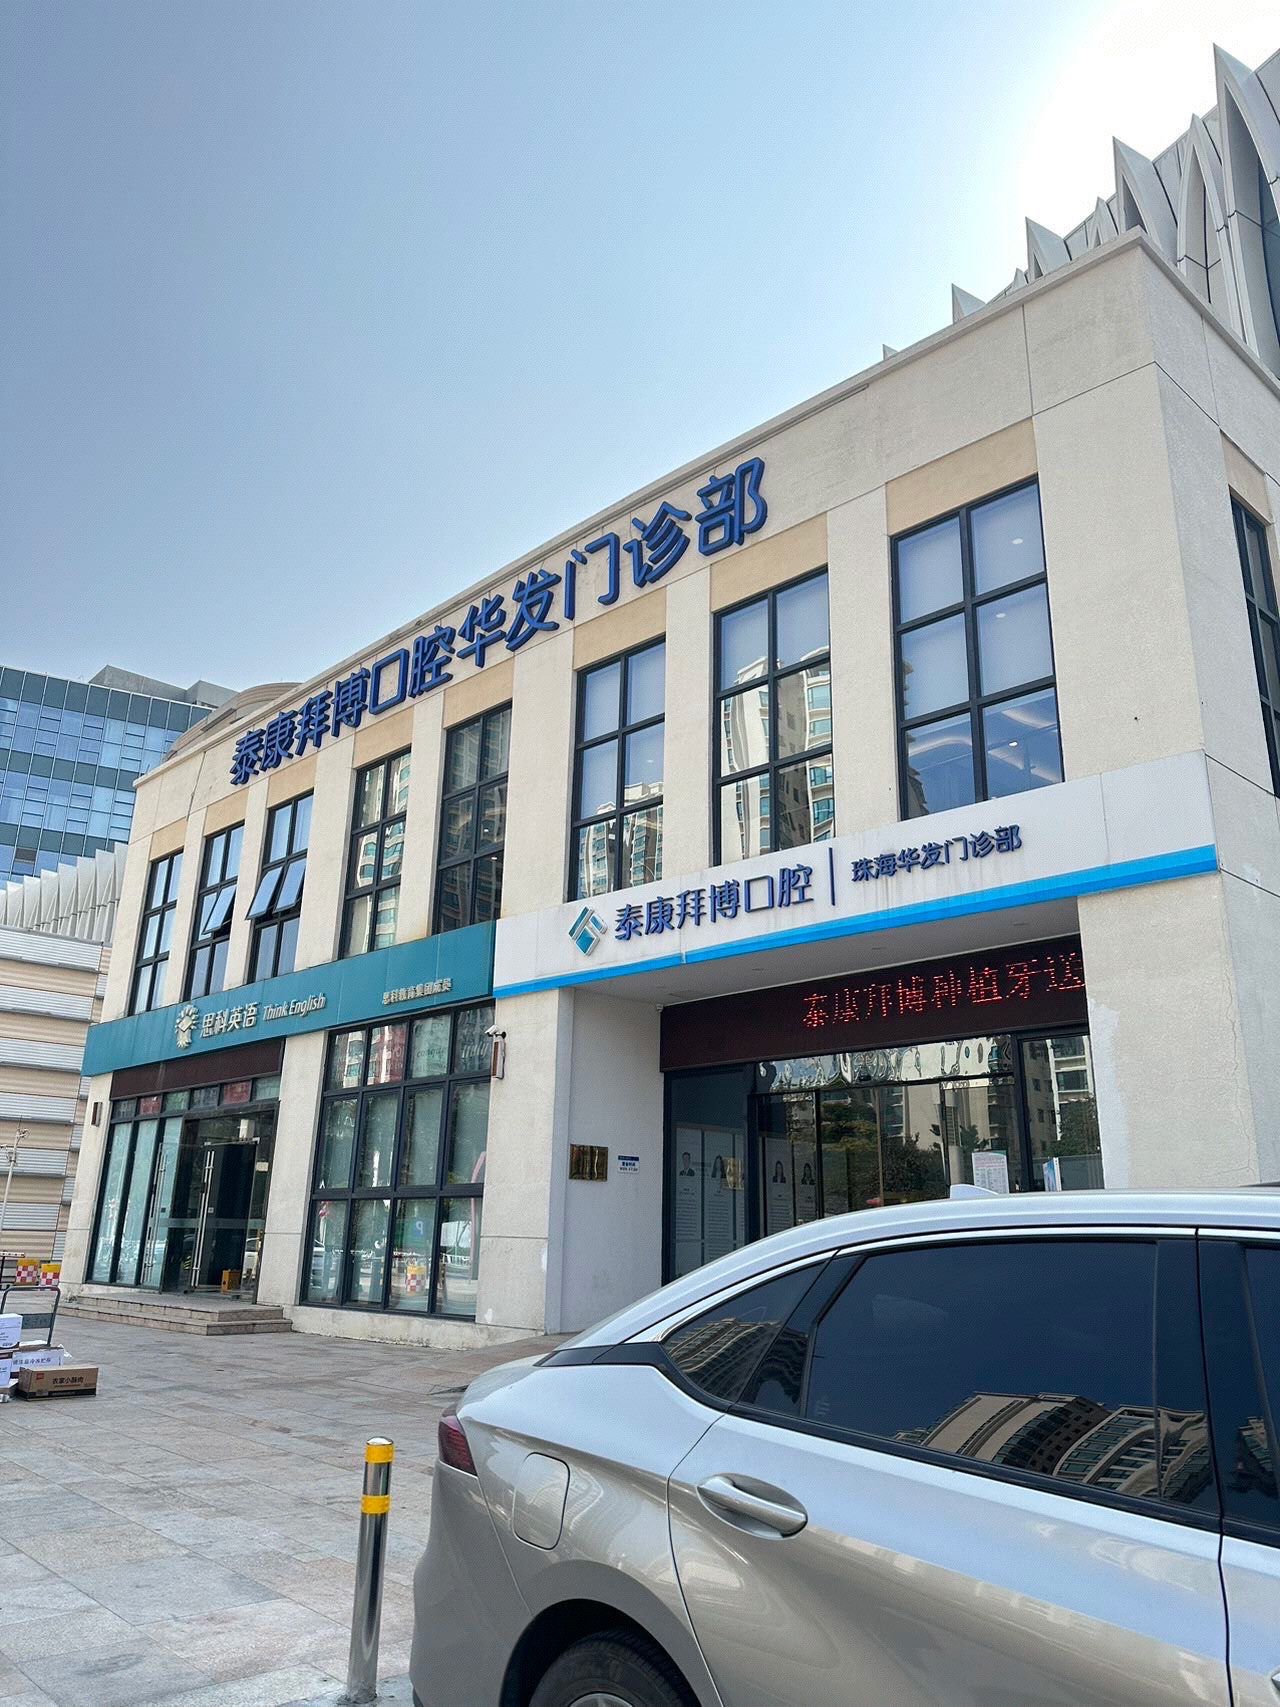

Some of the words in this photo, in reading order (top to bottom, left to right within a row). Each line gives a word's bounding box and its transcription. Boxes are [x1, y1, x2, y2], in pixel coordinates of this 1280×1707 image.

[230, 457, 768, 785] 泰康拜博口腔华发门诊部
[614, 864, 814, 941] 泰康拜博口腔
[851, 824, 1022, 883] 珠海华发门诊部
[200, 1001, 259, 1038] 思科英语
[262, 1002, 290, 1021] Think
[288, 992, 327, 1017] English
